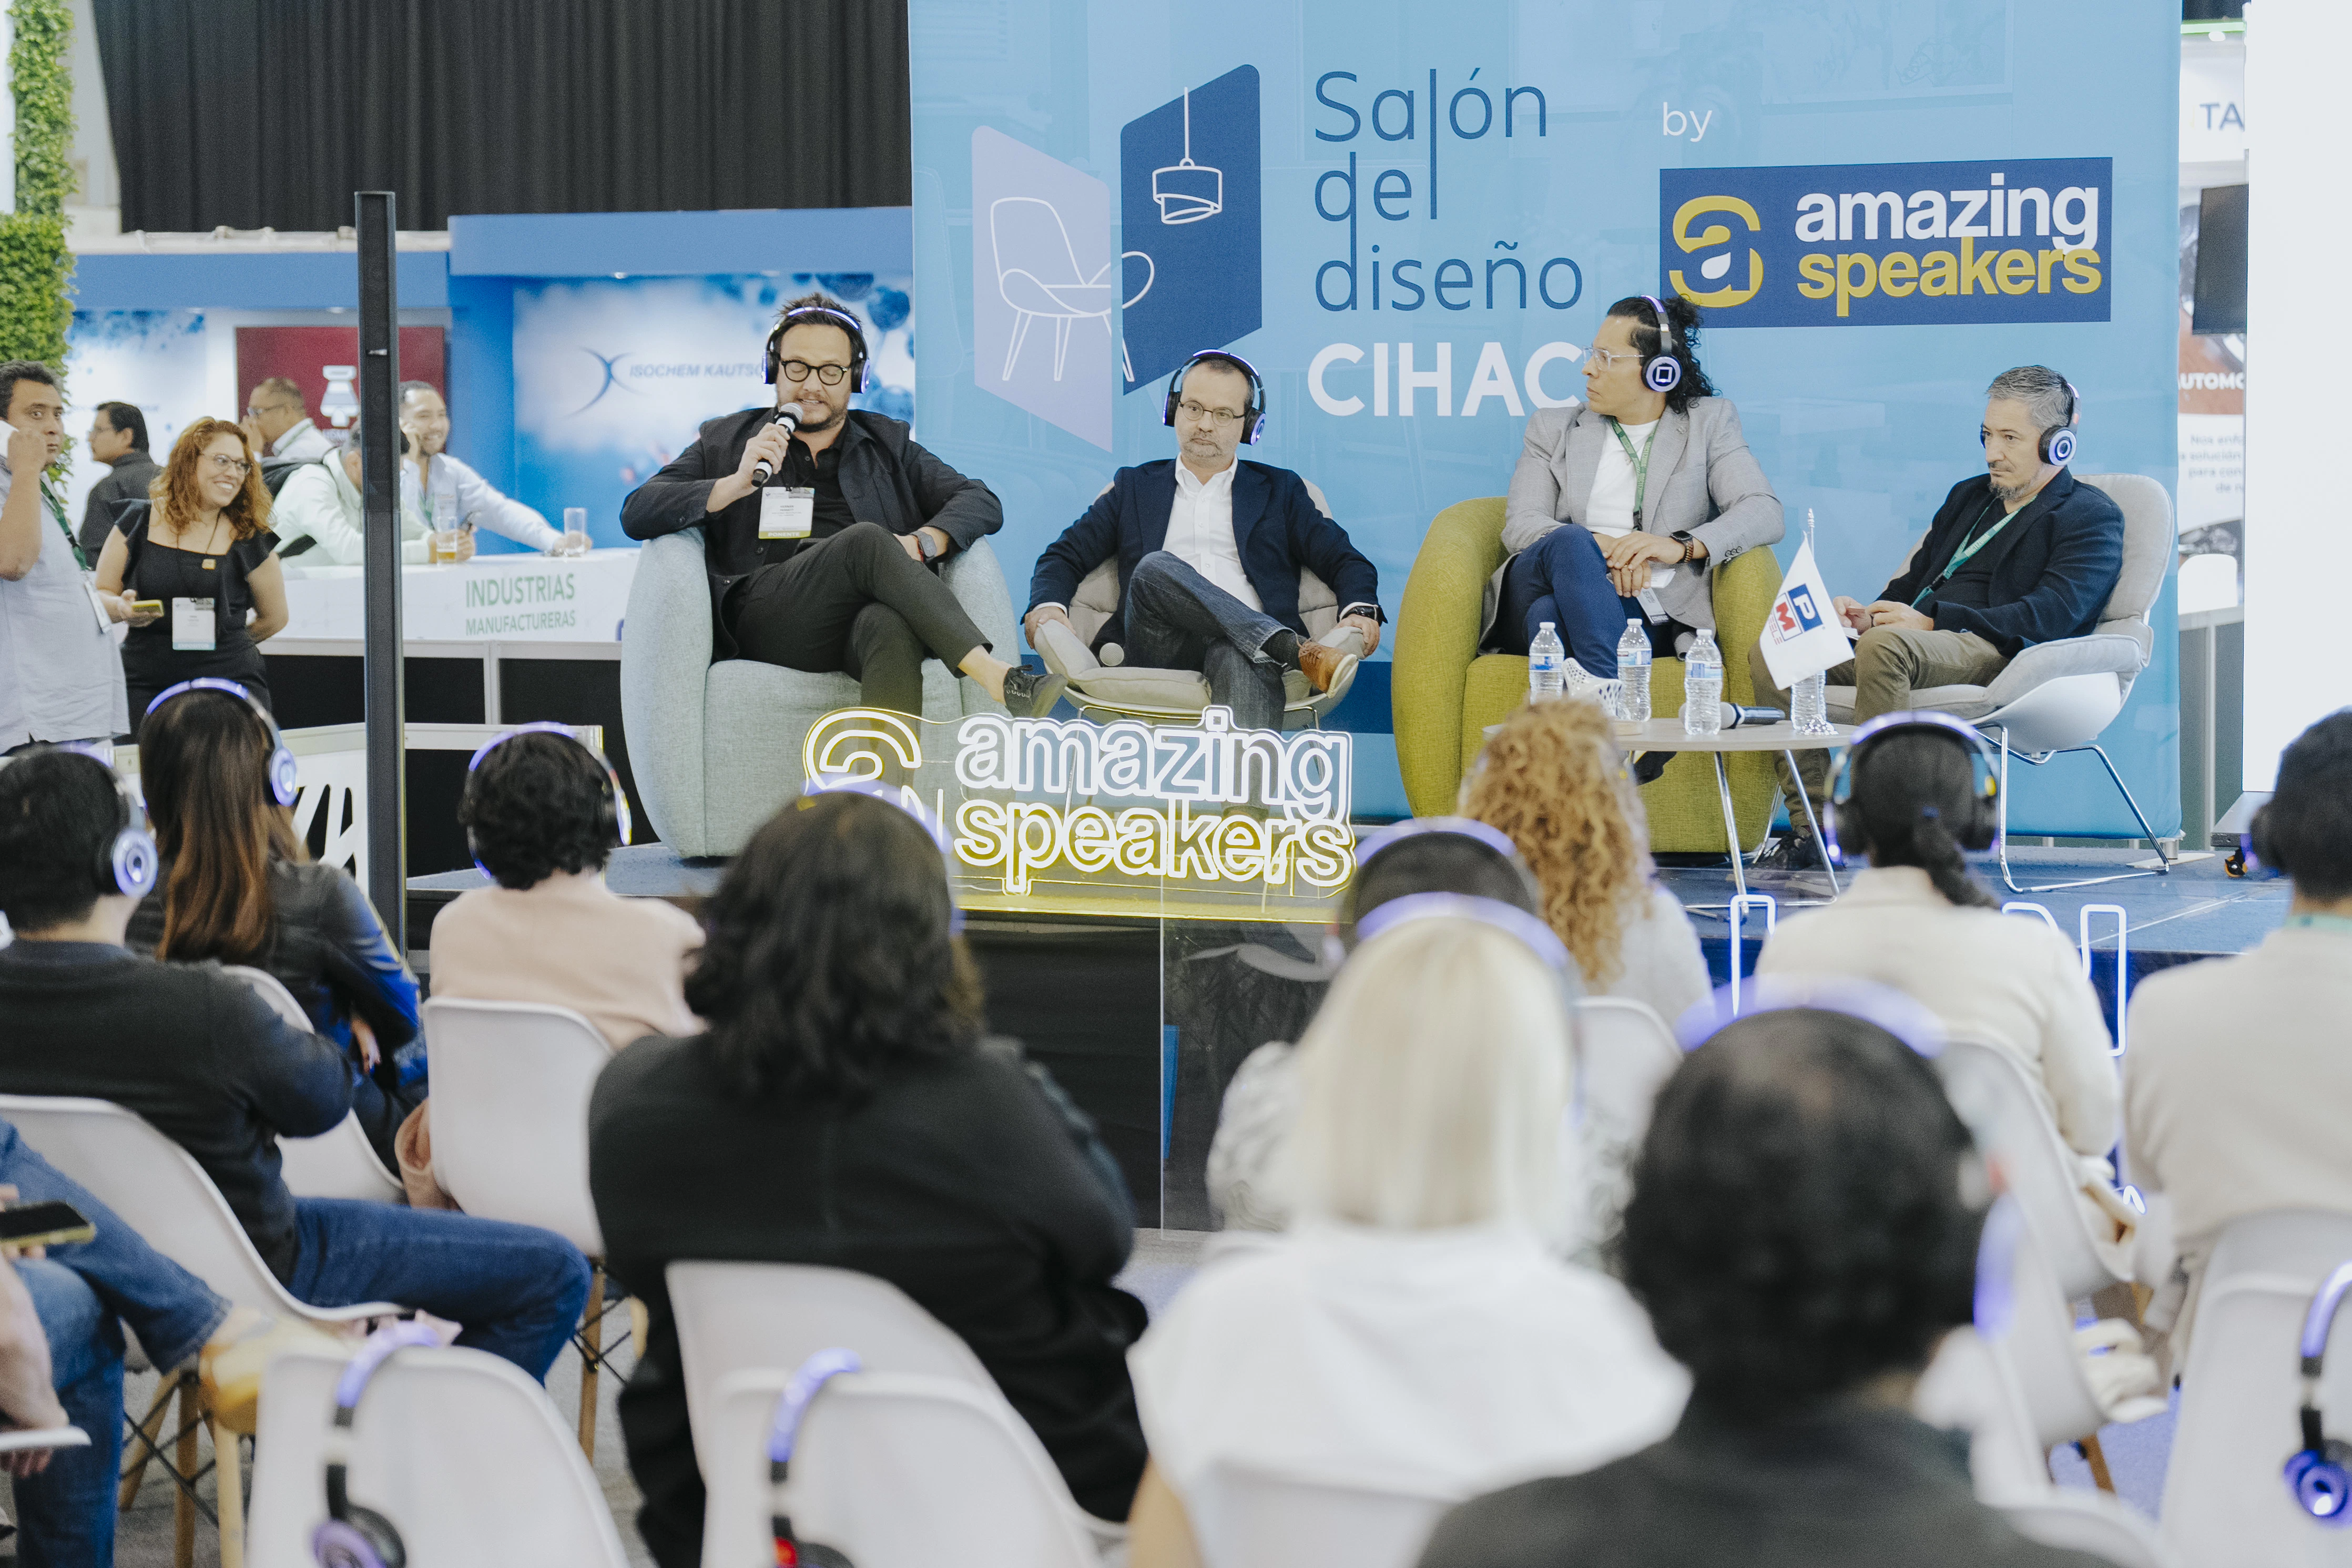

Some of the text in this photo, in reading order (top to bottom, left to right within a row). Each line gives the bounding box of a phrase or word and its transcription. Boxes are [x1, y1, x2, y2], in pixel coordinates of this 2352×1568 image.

[1315, 67, 1546, 143] Salón
[1662, 102, 1713, 142] by
[1315, 151, 1438, 222] del
[1795, 172, 2099, 256] amazing
[1315, 240, 1583, 311] diseño
[1797, 237, 2102, 317] speakers
[629, 363, 700, 378] ISOCHEM
[1307, 341, 1583, 416] CIHAC
[465, 573, 575, 608] INDUSTRIAS
[465, 609, 576, 636] MANUFACTURERAS
[954, 714, 1351, 822] amazing
[953, 799, 1355, 893] speakers
